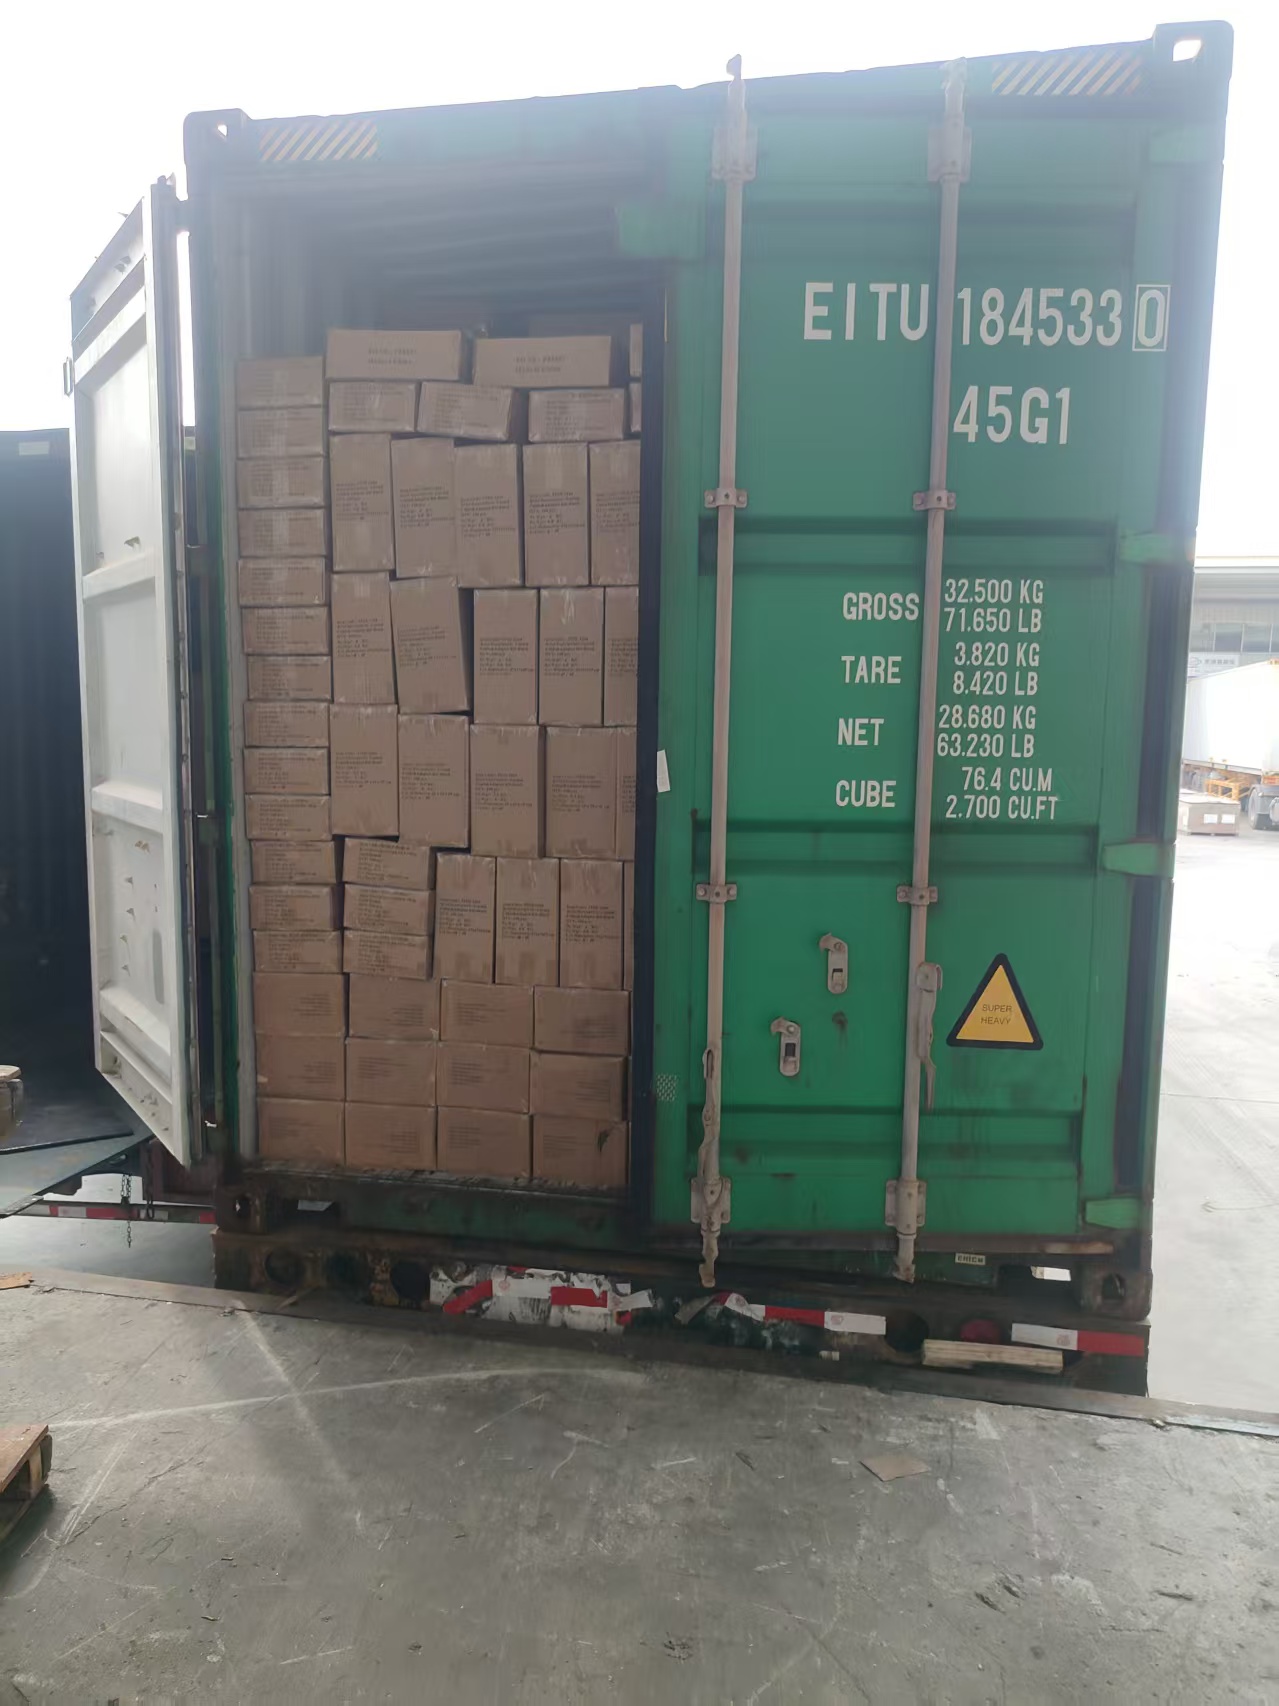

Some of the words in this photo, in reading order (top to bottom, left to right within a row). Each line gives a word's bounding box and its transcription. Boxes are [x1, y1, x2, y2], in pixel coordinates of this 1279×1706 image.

[804, 281, 930, 341] EITU
[956, 287, 1123, 347] 184533
[1136, 288, 1167, 348] 0
[953, 384, 1071, 444] 45G1
[944, 579, 1013, 603] 32.500
[1020, 579, 1044, 604] KG
[842, 592, 920, 621] GROSS
[943, 608, 1010, 633] 71.650
[1018, 609, 1042, 633] LB
[954, 642, 1009, 667] 3.820
[1016, 642, 1040, 667] KG
[841, 655, 902, 684] TARE
[952, 671, 1007, 695] 8.420
[1014, 671, 1038, 695] LB
[938, 704, 1006, 729] 28.680
[1012, 705, 1036, 730] KG
[837, 718, 884, 746] NET
[937, 733, 1004, 757] 63.230
[1011, 733, 1034, 758] LB
[961, 767, 1001, 791] 76.4
[1009, 767, 1053, 792] CU.M
[835, 780, 897, 808] CUBE
[945, 795, 1001, 819] 2.700
[1008, 795, 1058, 820] CU.FT
[980, 1016, 1011, 1025] HEAVY
[982, 1003, 1012, 1013] SUPER
